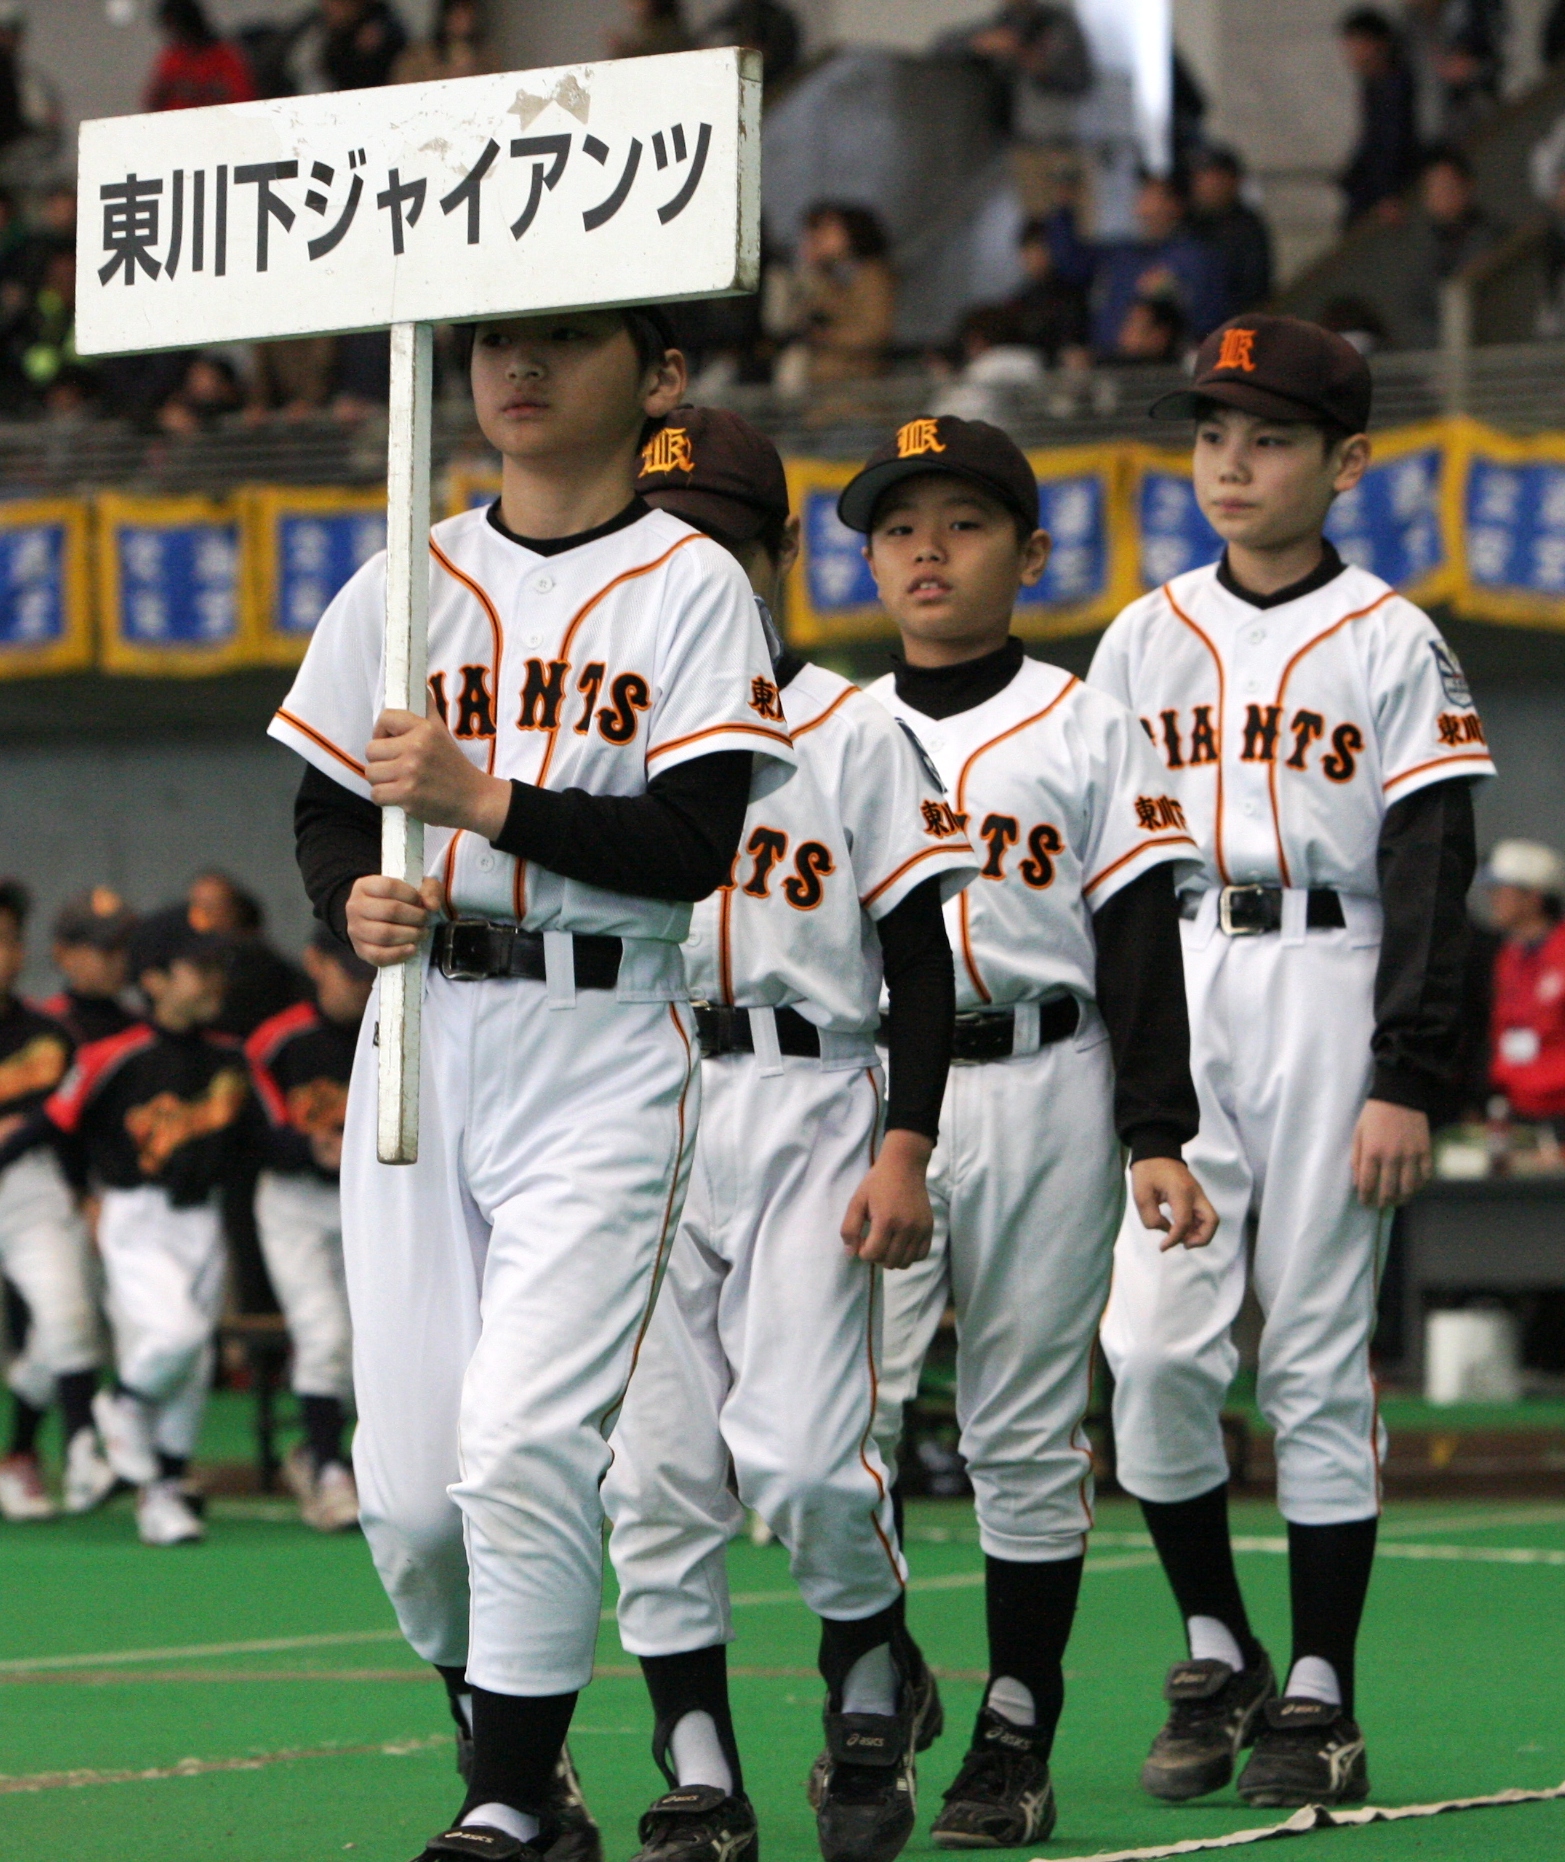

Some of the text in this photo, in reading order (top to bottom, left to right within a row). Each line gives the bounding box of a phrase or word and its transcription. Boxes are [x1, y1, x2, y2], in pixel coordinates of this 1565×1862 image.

[97, 122, 713, 288] 東川下ジャイアンツ
[1139, 703, 1365, 784] IANTS
